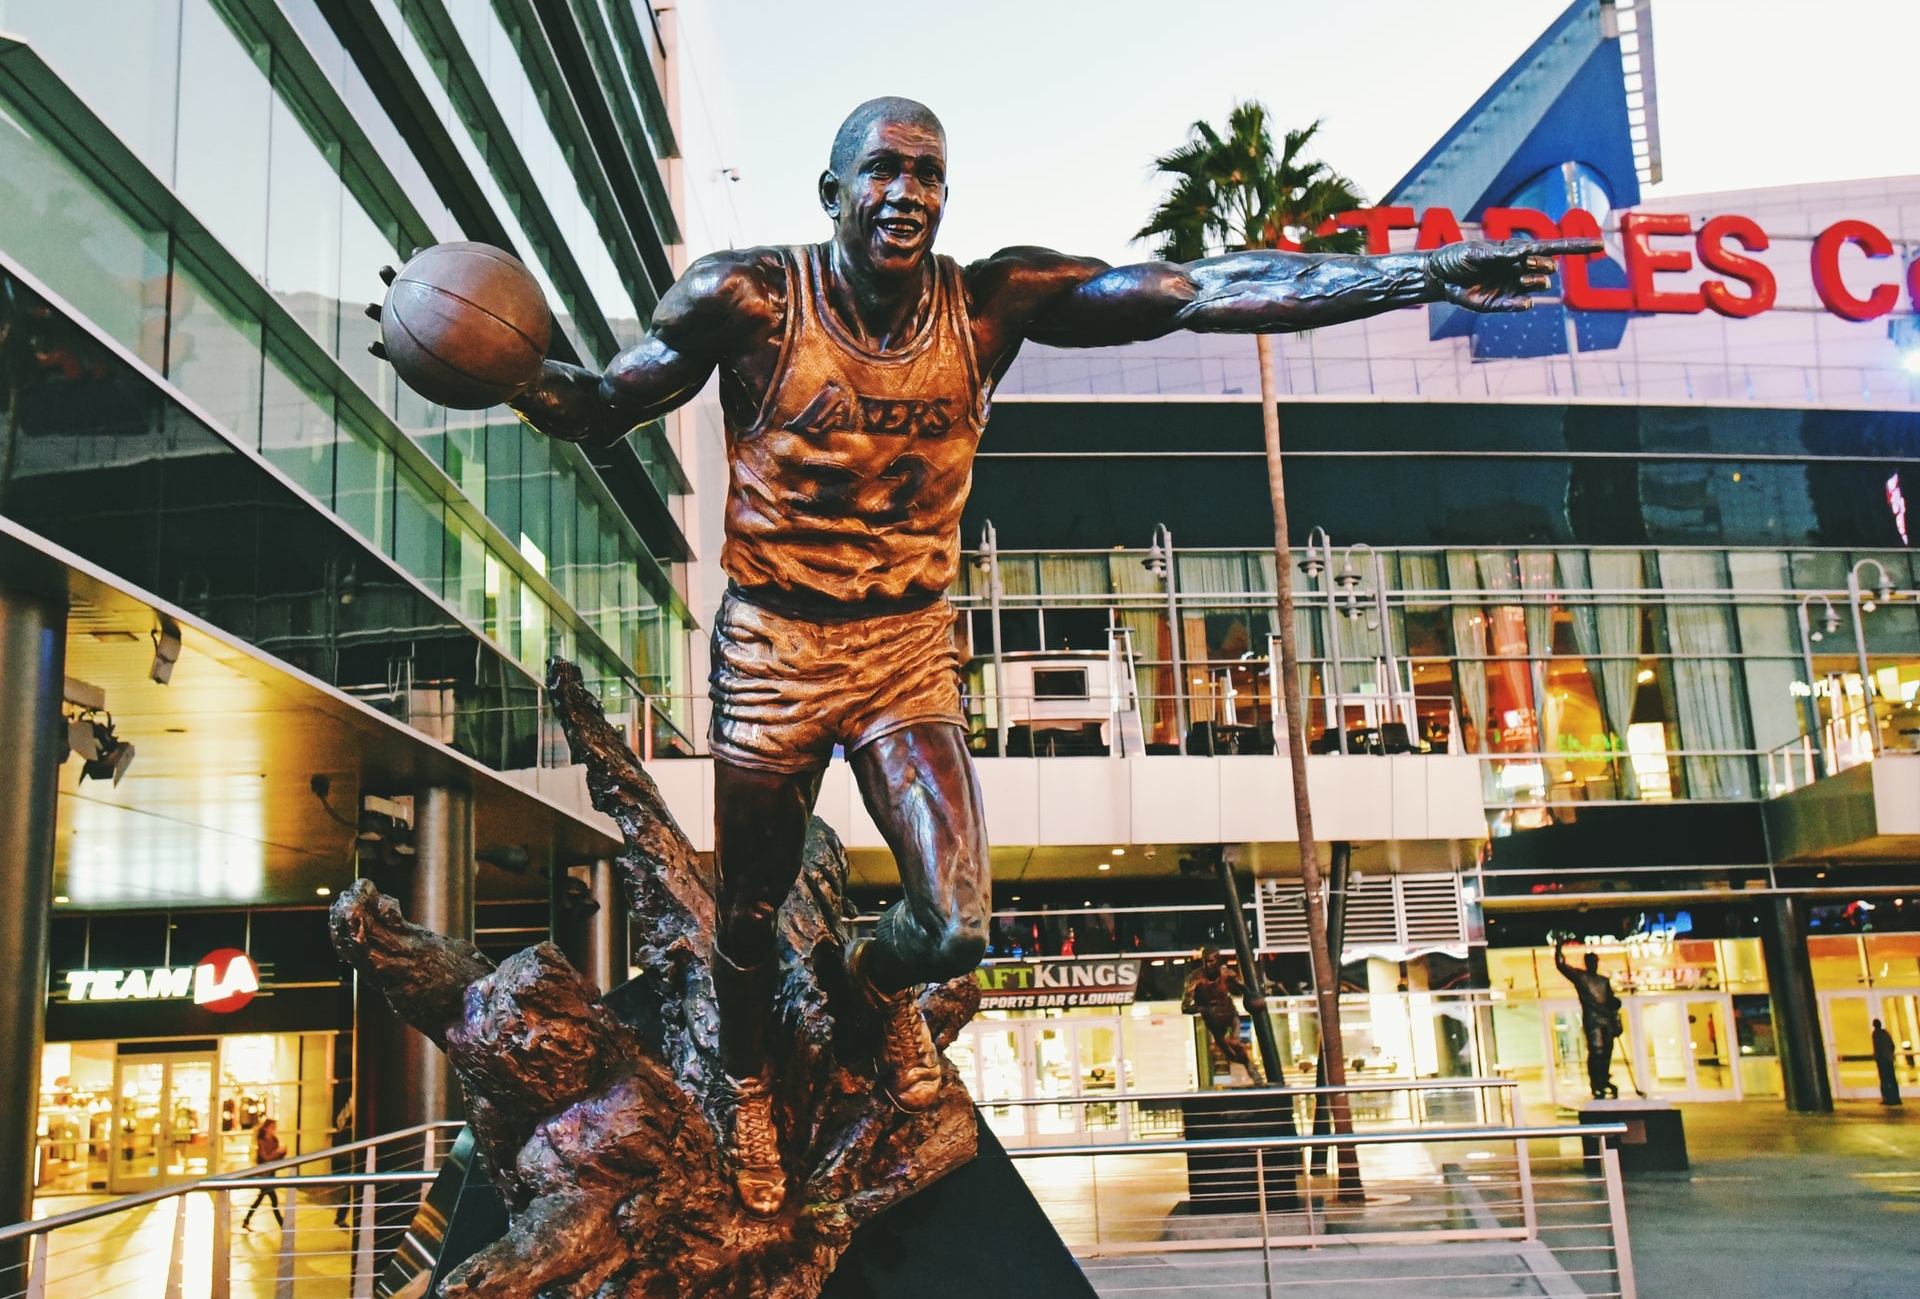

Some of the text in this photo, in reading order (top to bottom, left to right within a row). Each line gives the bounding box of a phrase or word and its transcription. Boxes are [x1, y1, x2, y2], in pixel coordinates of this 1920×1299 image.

[1264, 205, 1920, 323] TLES C
[66, 955, 259, 1004] TEAM LA
[979, 996, 1035, 1009] SPORTS
[1038, 994, 1065, 1007] BAR
[1080, 992, 1134, 1005] LOUNGE
